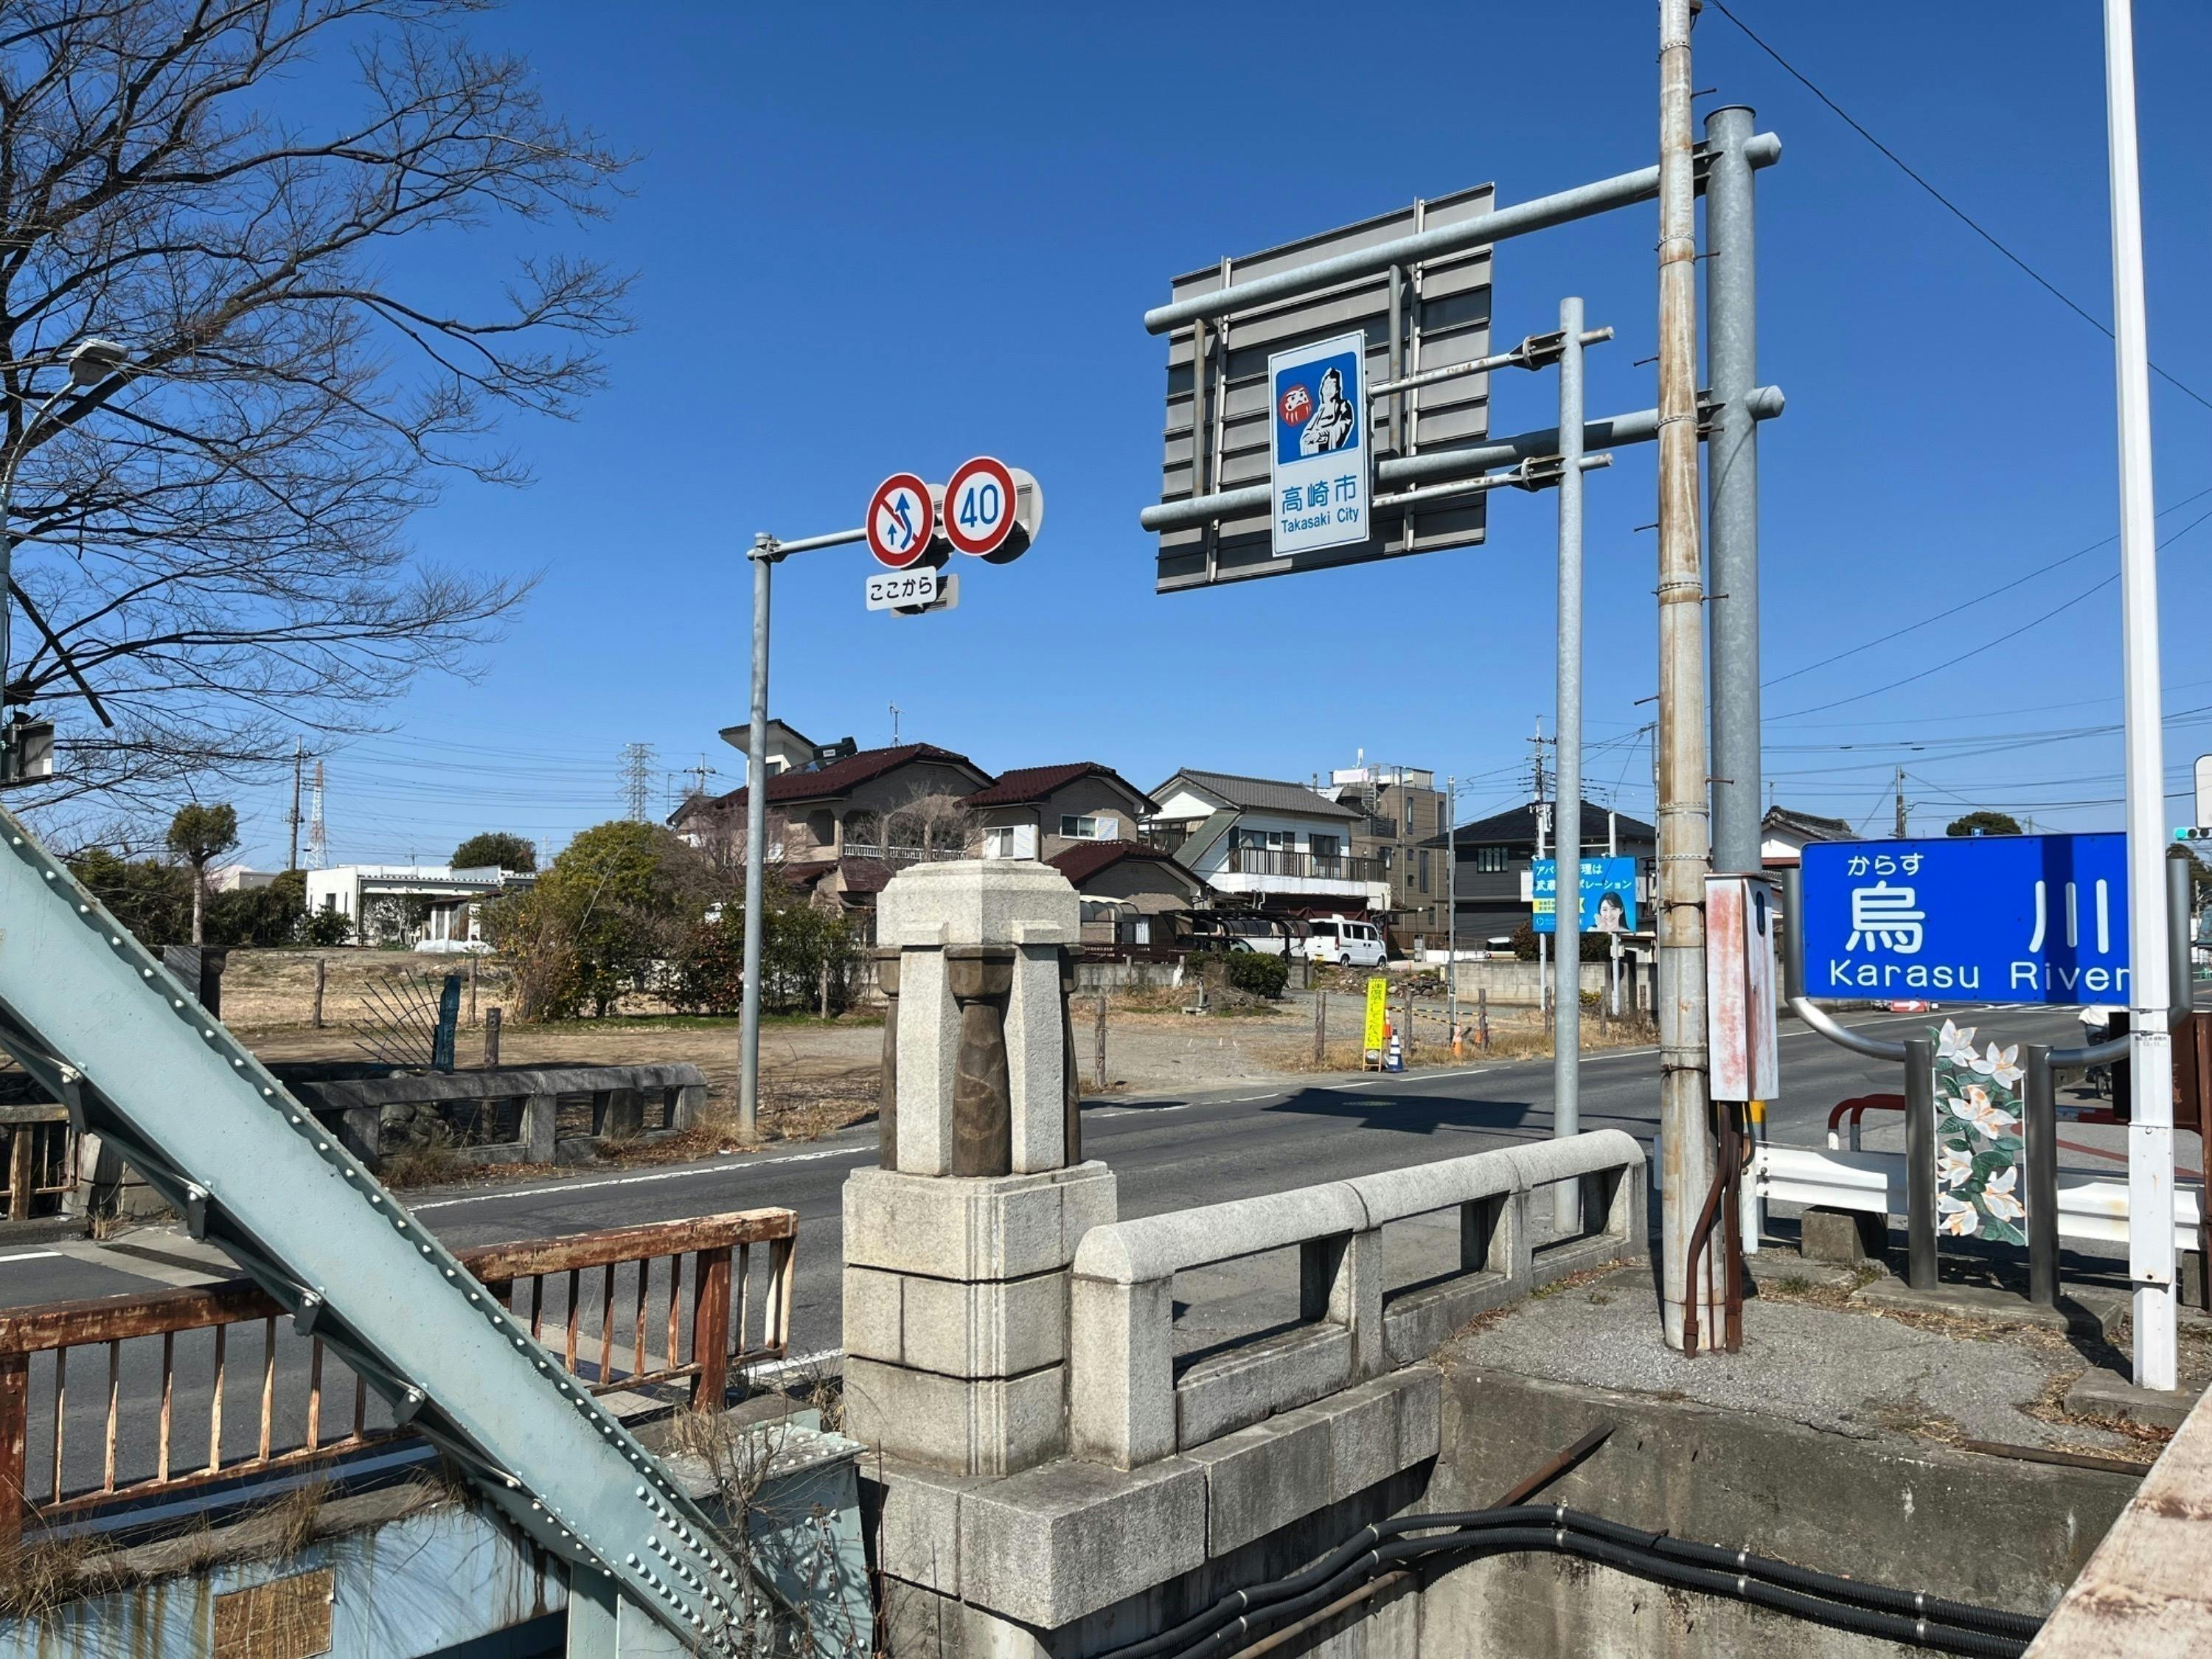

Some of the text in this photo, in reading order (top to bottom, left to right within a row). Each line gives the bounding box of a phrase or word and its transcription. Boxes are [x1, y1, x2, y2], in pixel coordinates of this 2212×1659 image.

[959, 484, 998, 528] 40
[1281, 474, 1357, 515] 高崎市
[1281, 507, 1359, 534] Takasaki City
[869, 577, 933, 601] ここから
[1537, 863, 1602, 875] アパ理は
[1847, 852, 1924, 877] からす
[1536, 879, 1632, 891] 武蔵レーション
[1830, 959, 2130, 992] Karasu River
